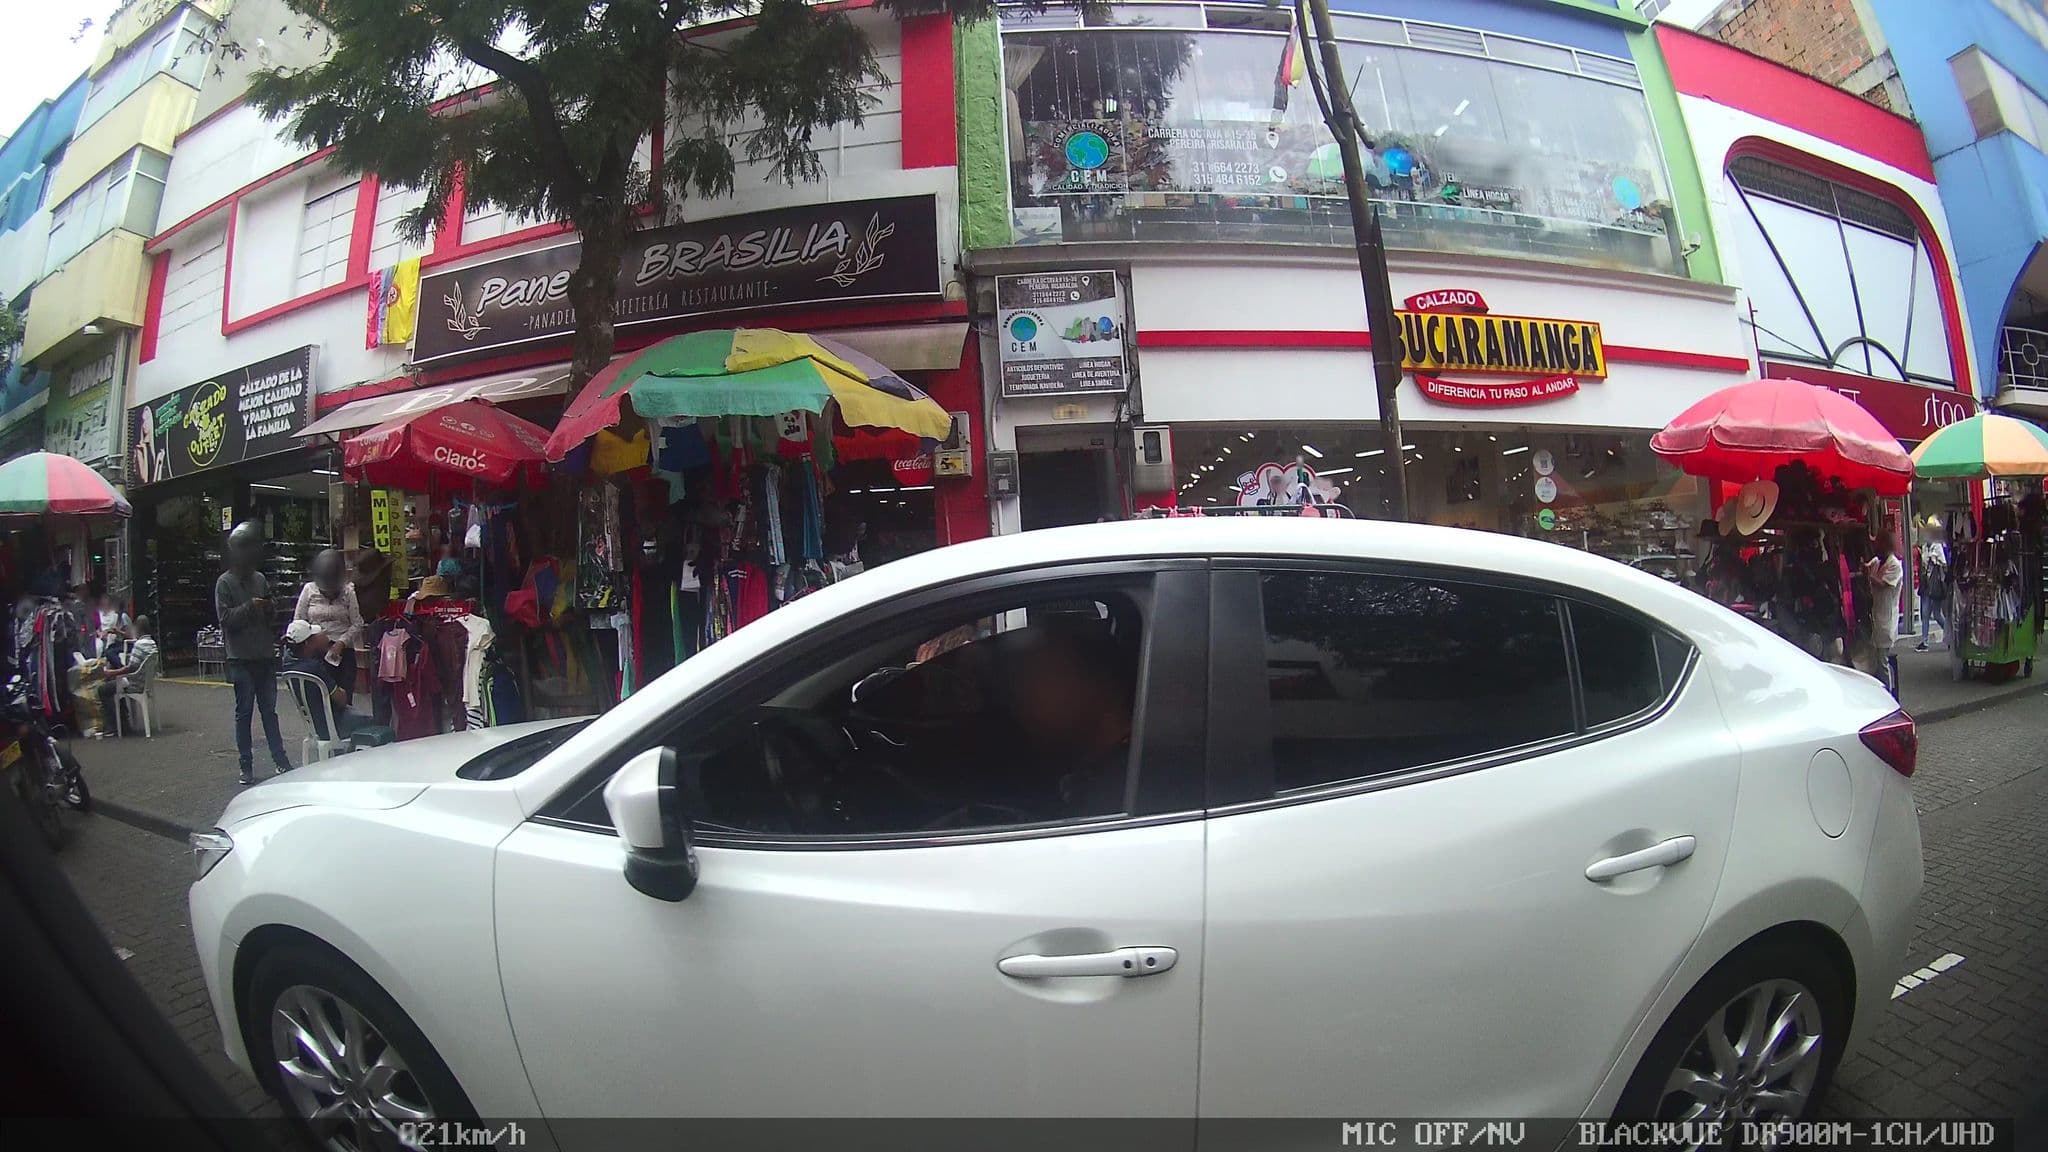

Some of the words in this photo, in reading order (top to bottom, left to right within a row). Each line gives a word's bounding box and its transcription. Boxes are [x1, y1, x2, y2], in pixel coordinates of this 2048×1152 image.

[1148, 128, 1189, 139] CARRERA
[1191, 129, 1223, 139] OCTAVA
[1234, 162, 1260, 174] 2273
[635, 221, 850, 287] BRASILIA
[476, 270, 573, 317] Pane
[1416, 291, 1476, 310] CALZADO
[523, 307, 577, 331] -PANADER
[610, 286, 668, 317] AFETERÍA
[239, 374, 277, 397] CALZADO
[278, 370, 291, 386] DE
[291, 366, 303, 381] LA
[1427, 381, 1487, 400] DIFERENCIA
[1490, 389, 1502, 399] TU
[1504, 385, 1528, 399] PASO
[1532, 384, 1544, 396] AL
[1545, 377, 1575, 394] ANDAR
[238, 394, 265, 413] MEJOR
[265, 382, 303, 405] CALIDAD
[242, 413, 251, 427] Y
[250, 408, 272, 424] PARA
[272, 400, 296, 418] TODA
[245, 427, 258, 441] LA
[257, 417, 292, 438] FAMILIA
[433, 446, 479, 471] Claro
